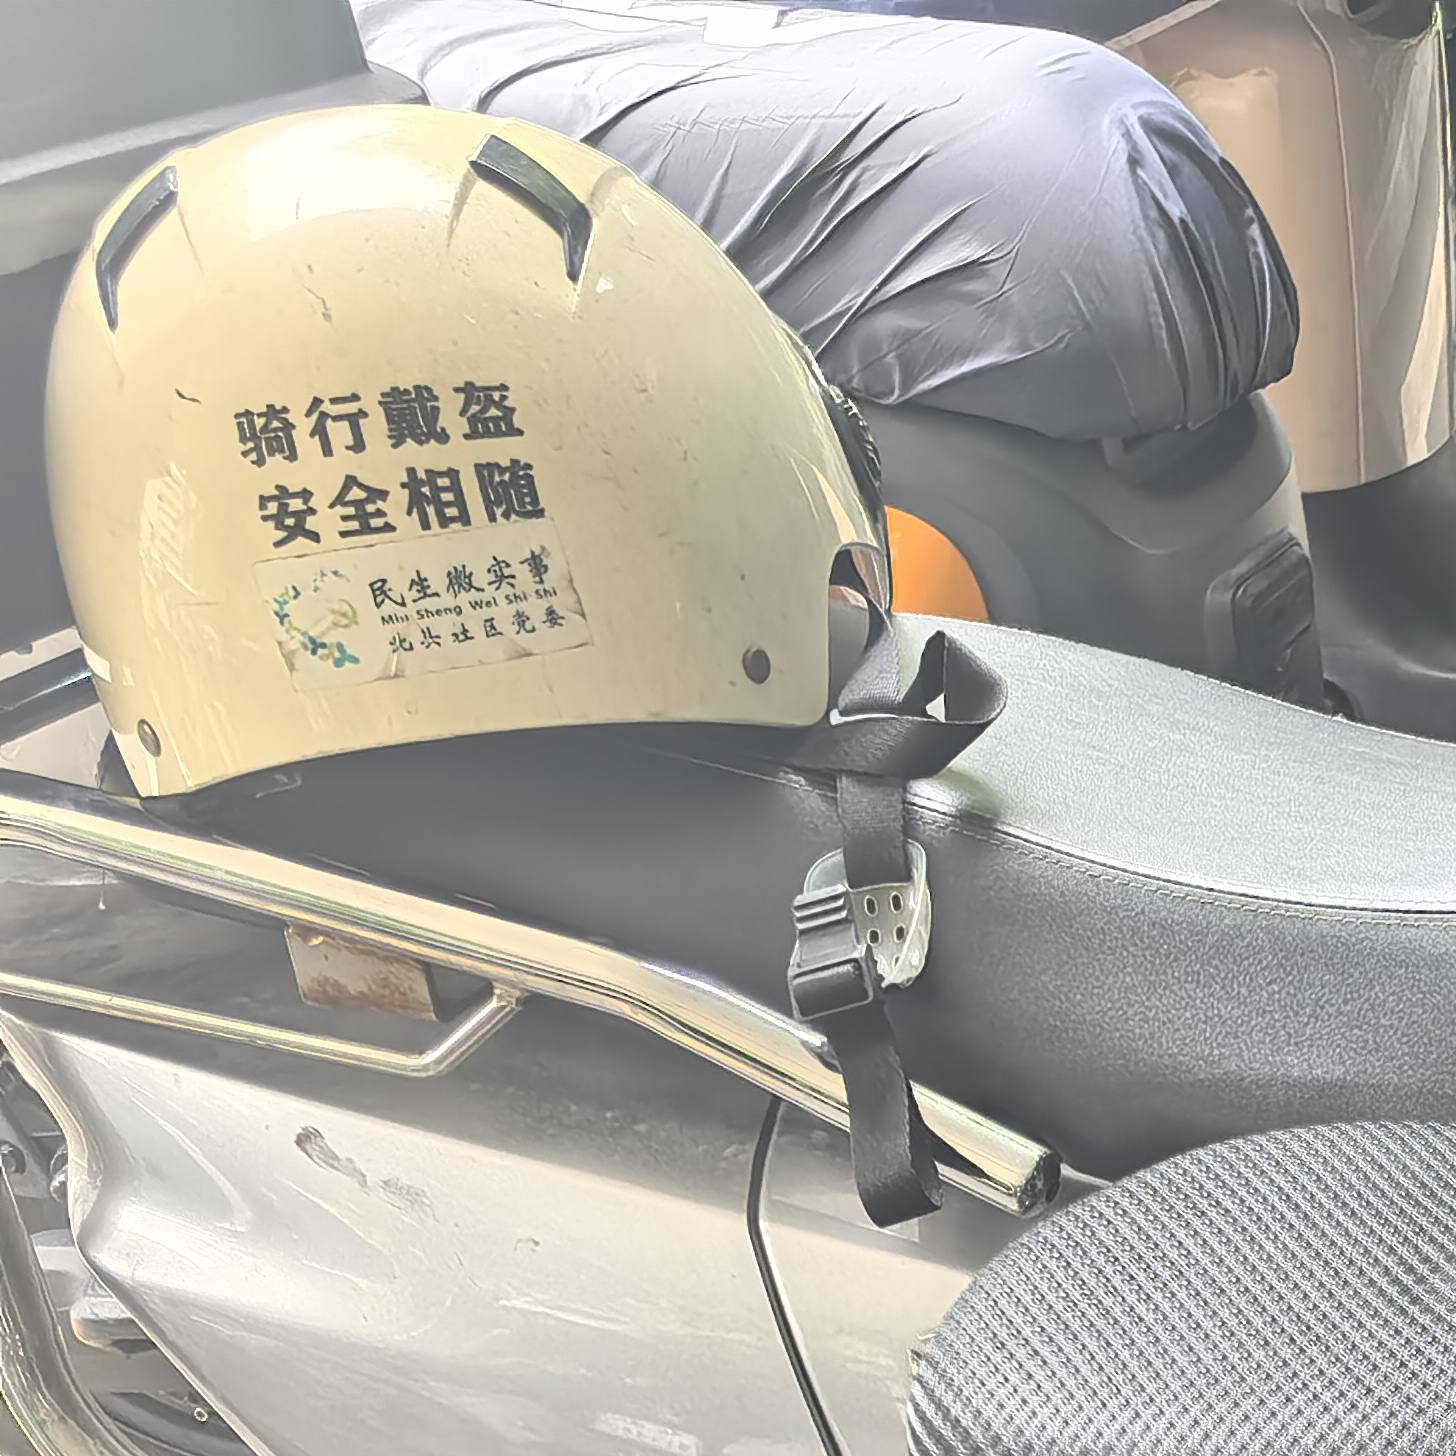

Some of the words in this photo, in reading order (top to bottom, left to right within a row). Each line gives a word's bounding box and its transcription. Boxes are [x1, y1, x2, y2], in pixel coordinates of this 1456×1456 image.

[233, 380, 525, 468] 骑行戴盔
[258, 457, 546, 549] 安全相随
[367, 544, 552, 611] 民生微实事
[416, 603, 463, 622] Sheng
